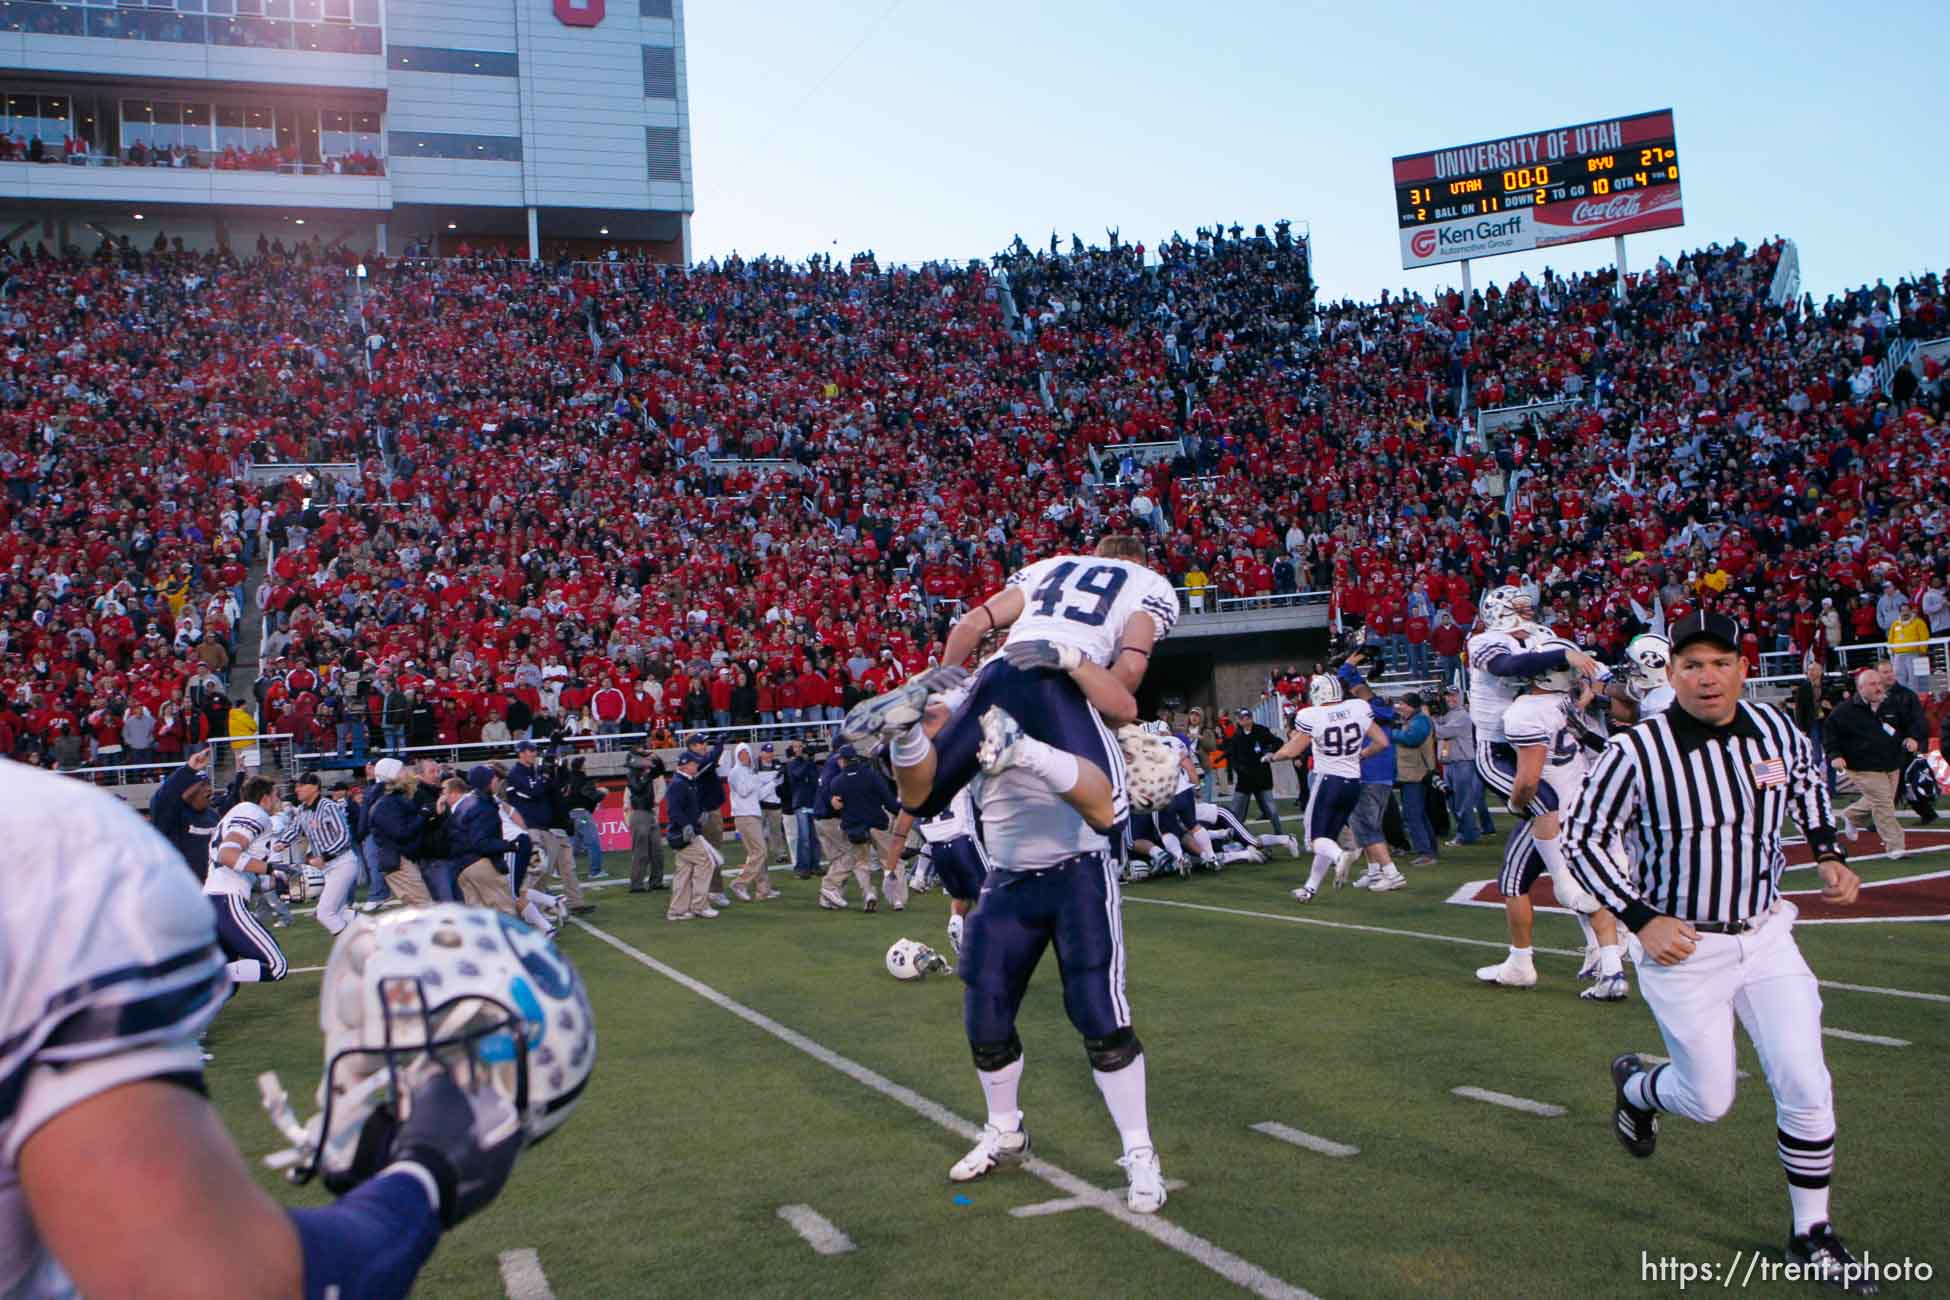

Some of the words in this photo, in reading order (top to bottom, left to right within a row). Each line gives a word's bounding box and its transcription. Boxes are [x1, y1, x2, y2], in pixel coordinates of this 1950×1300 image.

[1434, 135, 1539, 179] UNIVERSITY
[1546, 130, 1568, 159] OF
[1575, 122, 1622, 154] UTAH
[1641, 147, 1663, 166] 27
[1587, 156, 1614, 172] BYU
[1634, 172, 1647, 186] 4
[1667, 166, 1678, 179] 0
[1450, 179, 1483, 195] UTAH
[1593, 178, 1609, 194] 10
[1614, 177, 1634, 190] QTR
[1410, 188, 1431, 205] 31
[1504, 193, 1534, 208] DOWN
[1535, 189, 1546, 205] 2
[1552, 188, 1566, 200] TO
[1570, 185, 1585, 197] GO
[1434, 206, 1458, 219] BALL
[1462, 203, 1475, 214] ON
[1481, 197, 1499, 213] 11
[1572, 192, 1643, 224] Coca-Cola
[1417, 208, 1427, 221] 2
[1438, 226, 1474, 245] Ken
[1476, 215, 1521, 239] Garff
[1440, 243, 1487, 255] Automotive
[1487, 239, 1513, 249] Group
[1032, 560, 1128, 626] 49
[1324, 722, 1362, 757] 92
